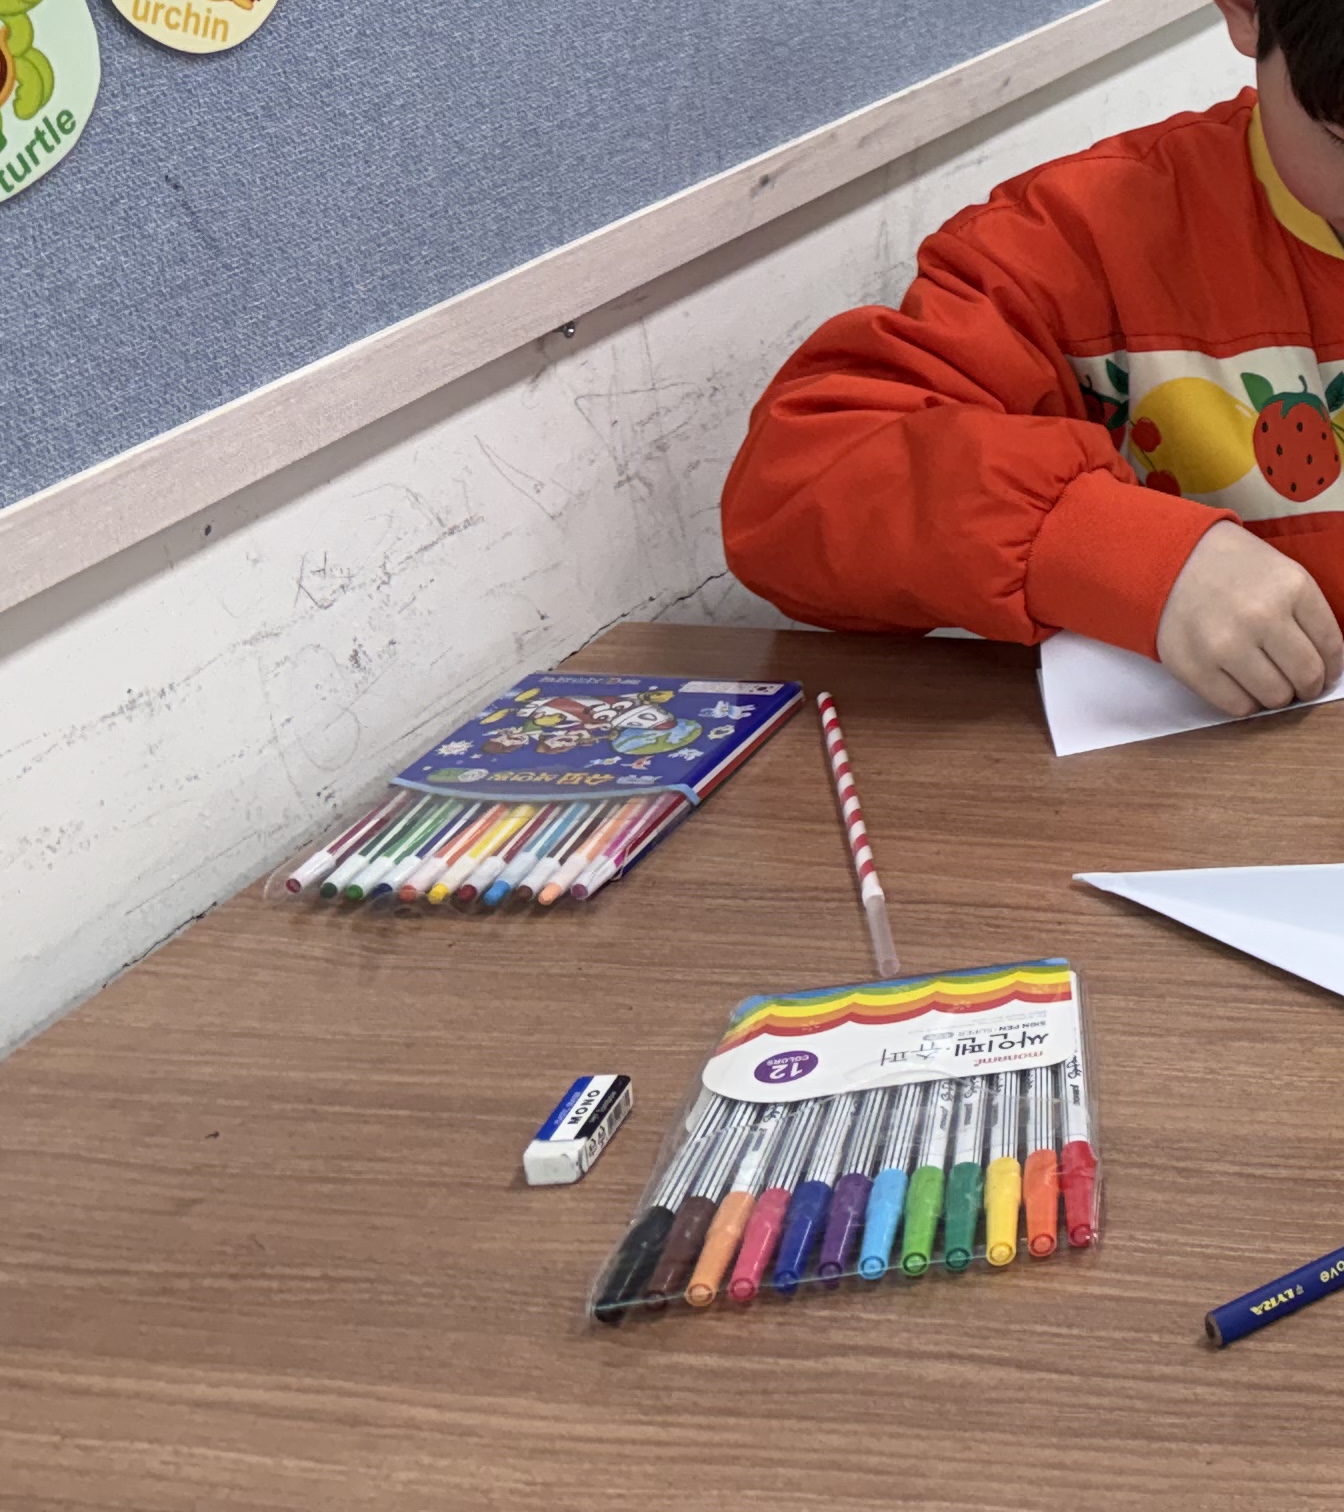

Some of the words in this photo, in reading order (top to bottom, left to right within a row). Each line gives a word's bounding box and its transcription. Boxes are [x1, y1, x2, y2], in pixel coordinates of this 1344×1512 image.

[0, 109, 76, 193] turtle
[766, 1054, 810, 1067] COLORS
[769, 1063, 804, 1083] 12
[567, 1089, 600, 1125] MONO
[1249, 1286, 1296, 1317] LYRA
